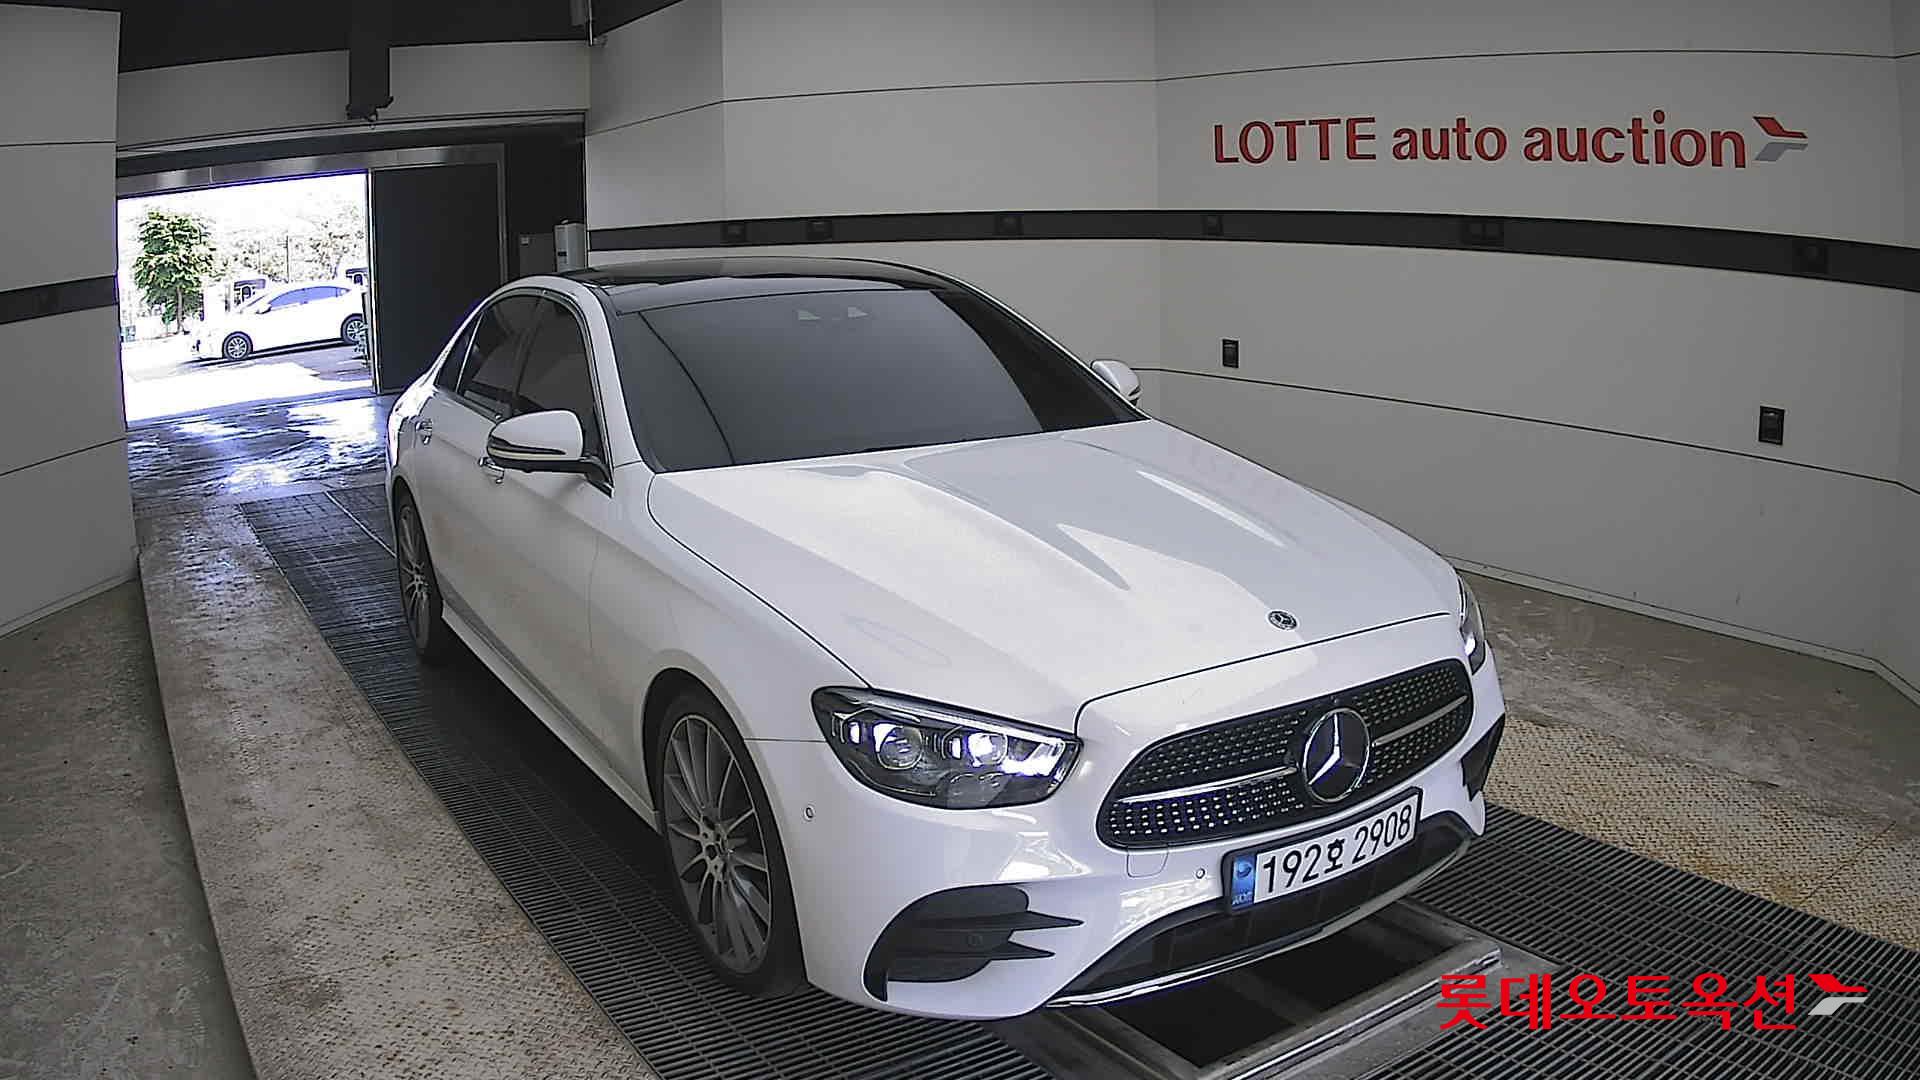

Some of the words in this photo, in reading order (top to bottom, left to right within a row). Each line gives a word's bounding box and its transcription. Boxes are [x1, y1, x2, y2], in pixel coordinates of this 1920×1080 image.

[1213, 117, 1377, 164] LOTTE
[1392, 117, 1508, 162] auto
[1523, 110, 1747, 169] auction
[1263, 838, 1345, 894] 192호
[1351, 804, 1412, 865] 2908
